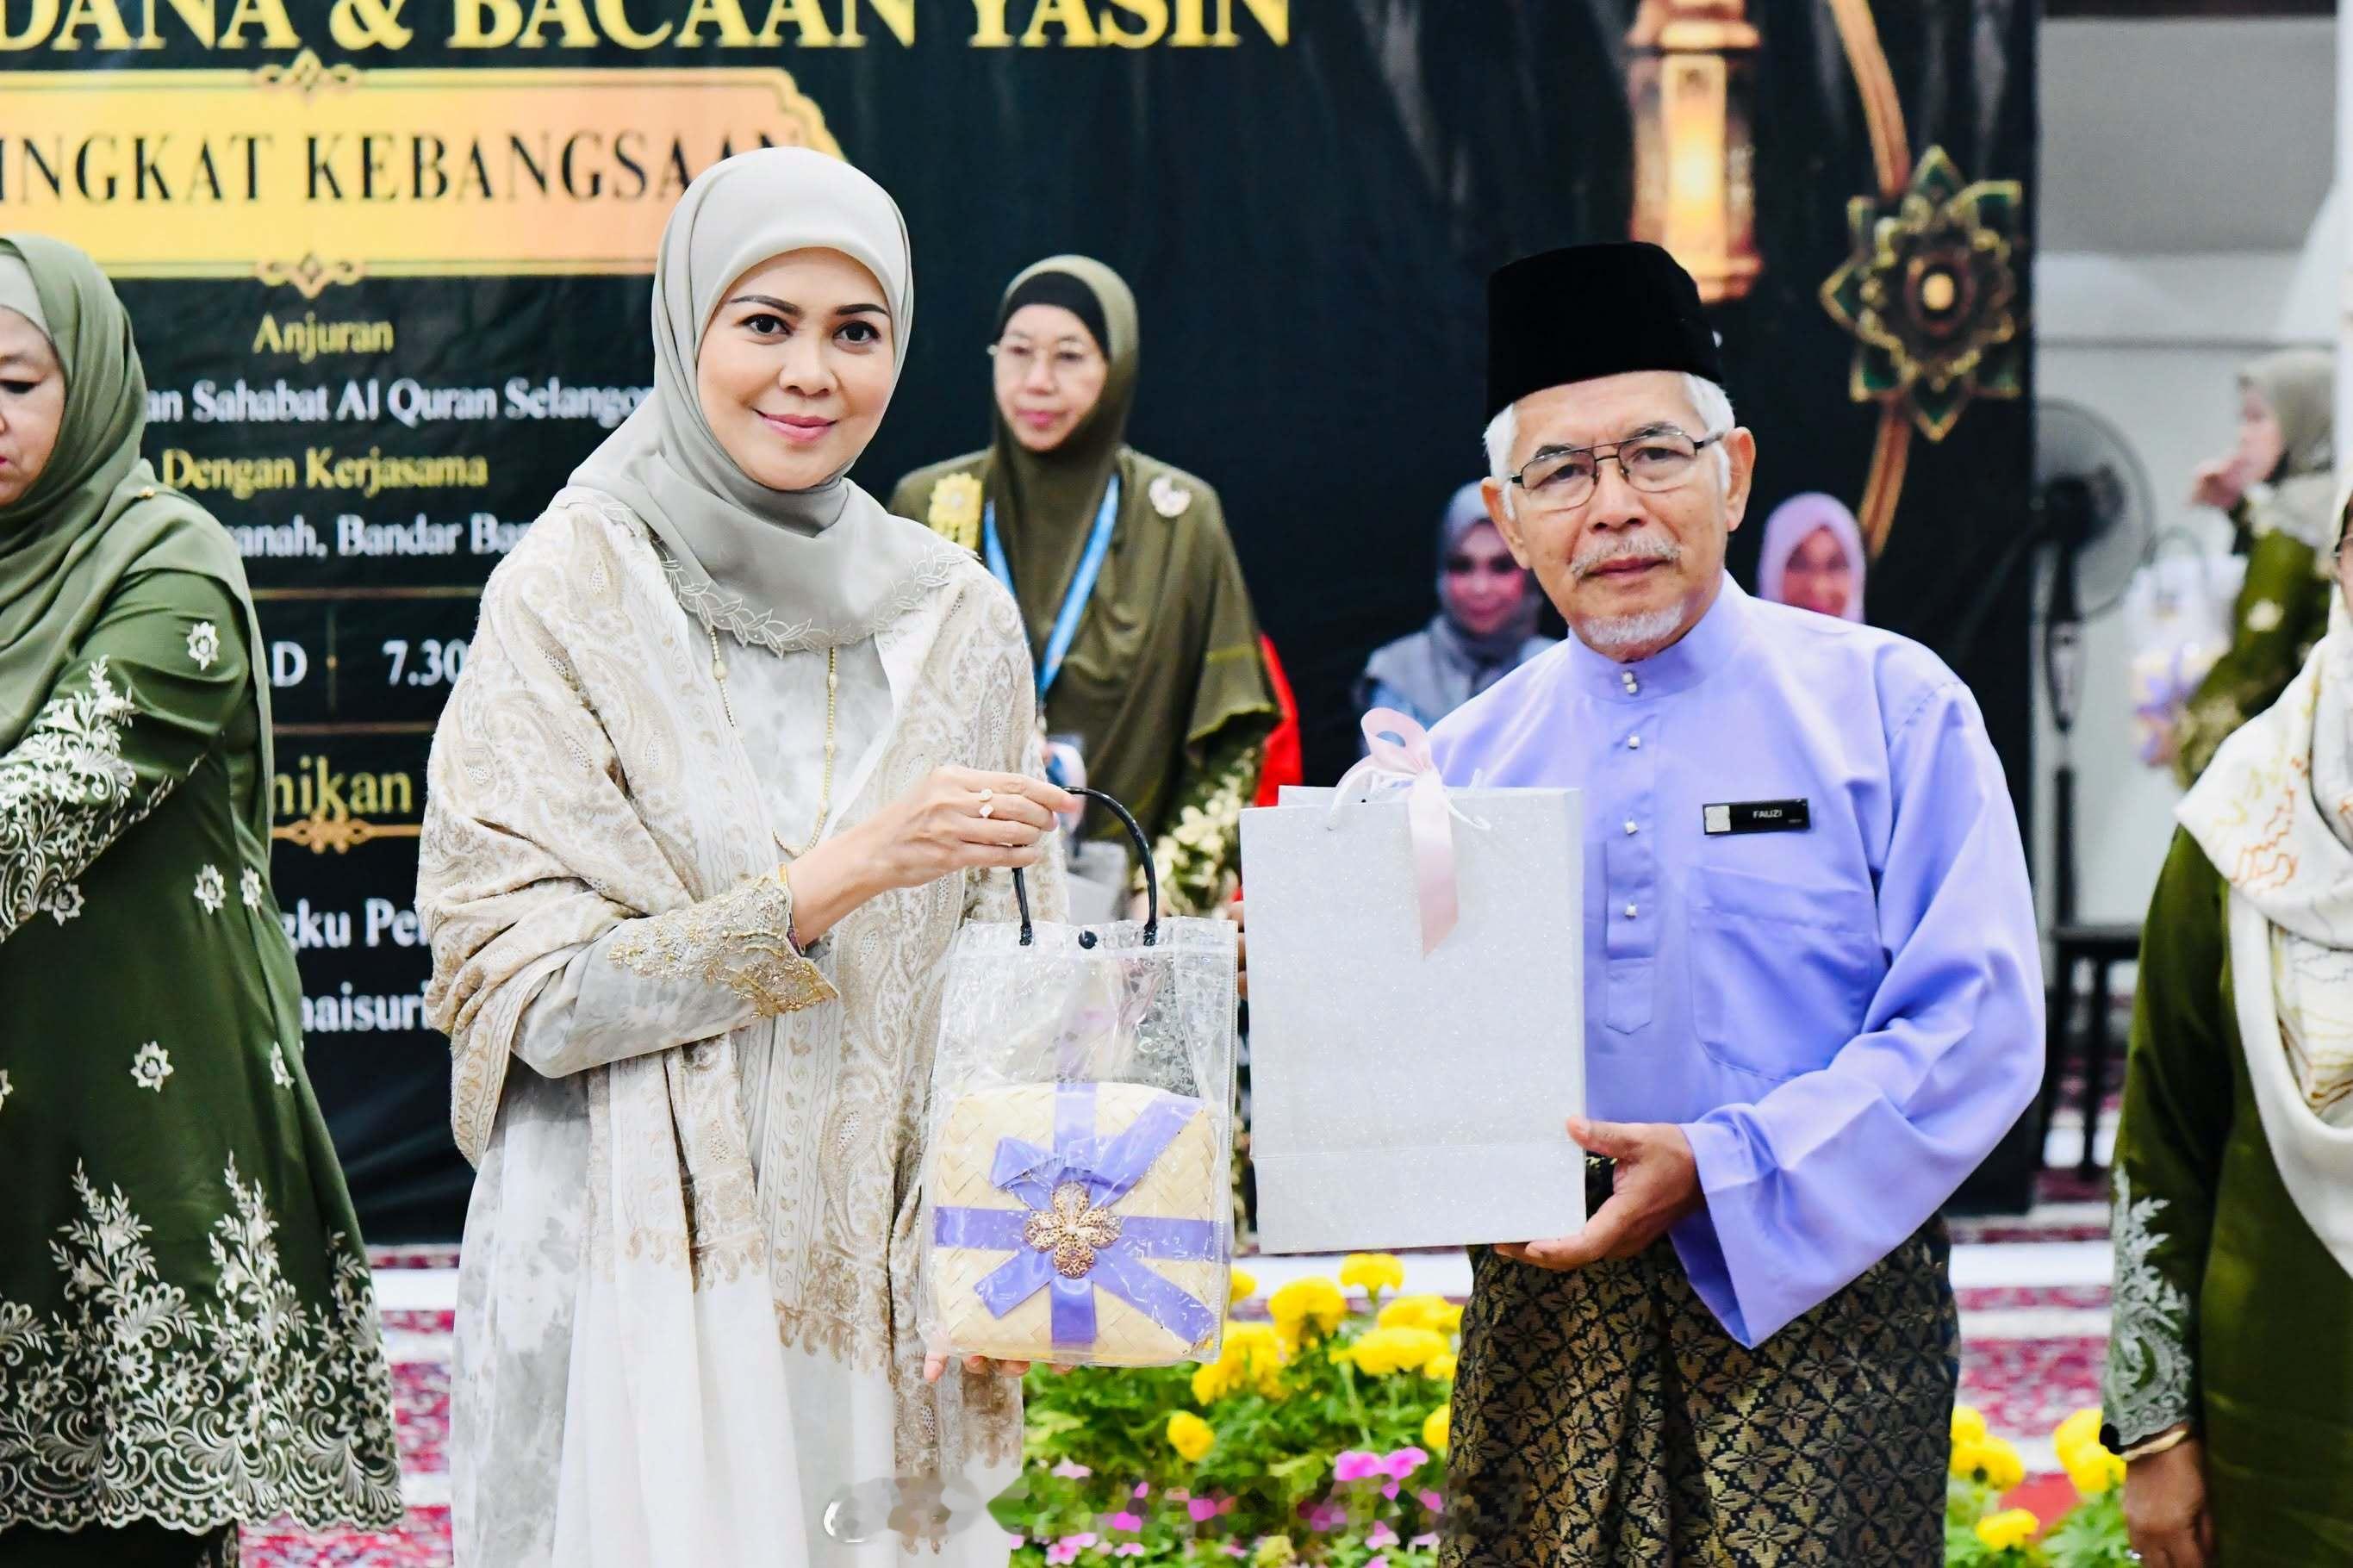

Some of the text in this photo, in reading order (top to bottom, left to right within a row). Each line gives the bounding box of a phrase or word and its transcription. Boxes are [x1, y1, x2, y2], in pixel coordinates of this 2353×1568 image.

[330, 0, 413, 50] &
[449, 0, 915, 49] BACAAN
[968, 0, 1290, 49] YASIN
[305, 131, 800, 202] KEBANGSA
[252, 312, 394, 364] Anjuran
[192, 378, 330, 423] Sahabat
[335, 378, 380, 421] Al
[386, 378, 498, 428] Quran
[504, 376, 654, 428] Selango
[162, 446, 489, 500] Dengan Kerjasama
[228, 513, 327, 558] anah,
[337, 513, 464, 557] Bandar
[382, 638, 469, 687] 7.30
[1752, 809, 1783, 818] FAUZI
